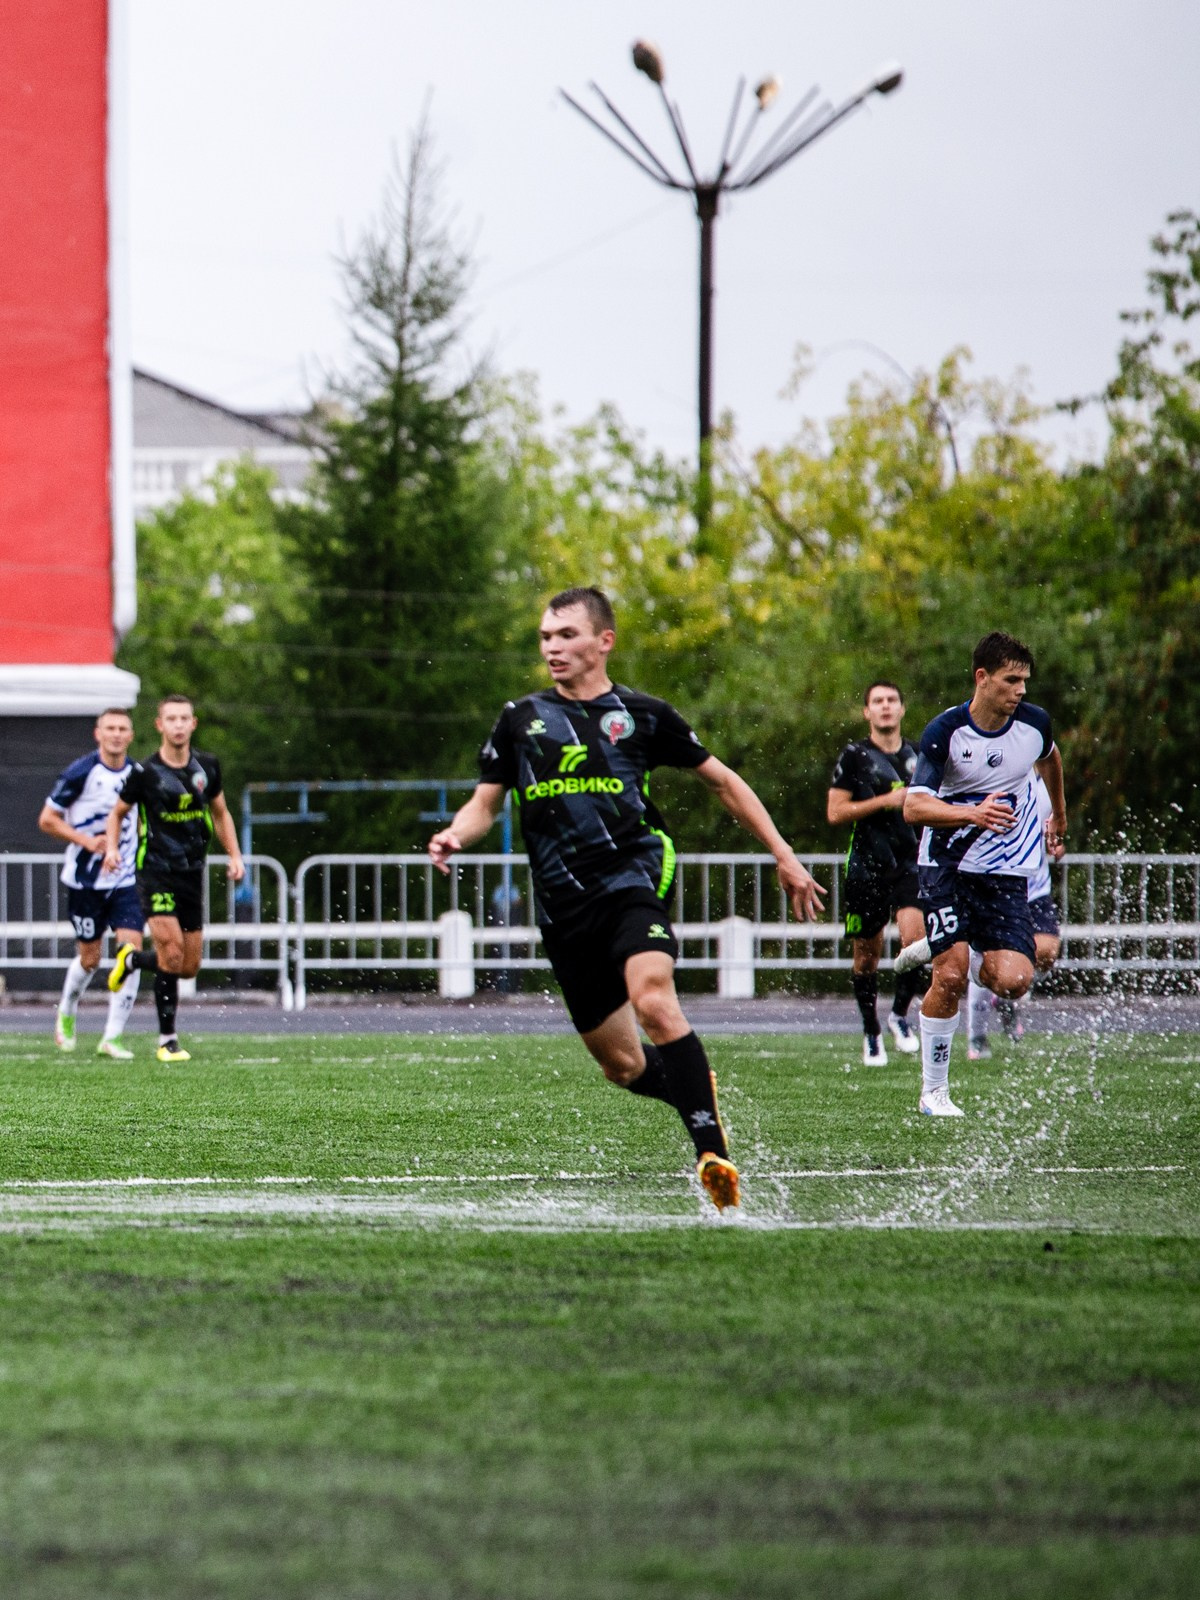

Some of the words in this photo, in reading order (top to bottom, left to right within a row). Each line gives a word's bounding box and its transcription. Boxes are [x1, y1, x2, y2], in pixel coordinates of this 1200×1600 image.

[525, 776, 624, 801] сервико
[150, 892, 176, 913] 23
[927, 905, 960, 942] 25
[933, 1051, 949, 1063] 25
